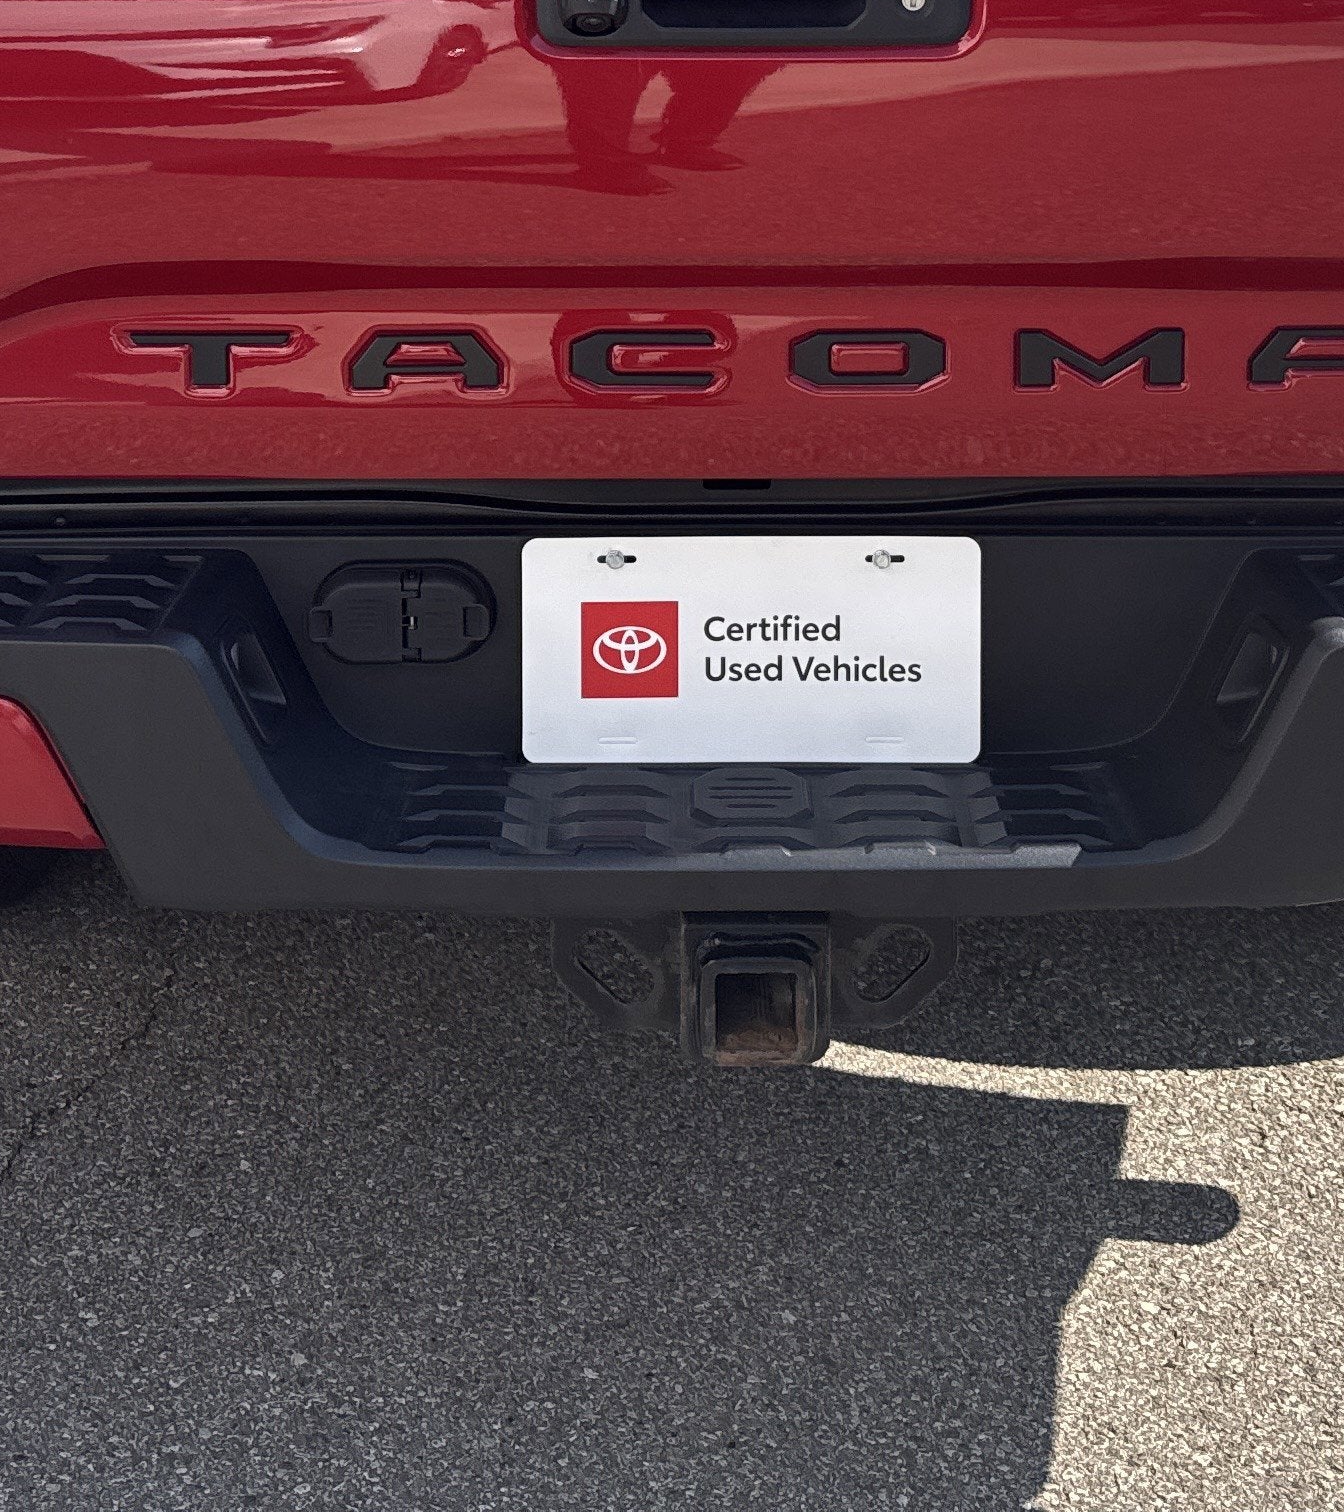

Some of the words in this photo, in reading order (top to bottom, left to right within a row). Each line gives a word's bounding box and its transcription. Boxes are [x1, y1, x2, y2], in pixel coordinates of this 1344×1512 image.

[703, 615, 841, 642] Certified
[703, 655, 783, 682] Used
[791, 655, 922, 682] Vehicles
